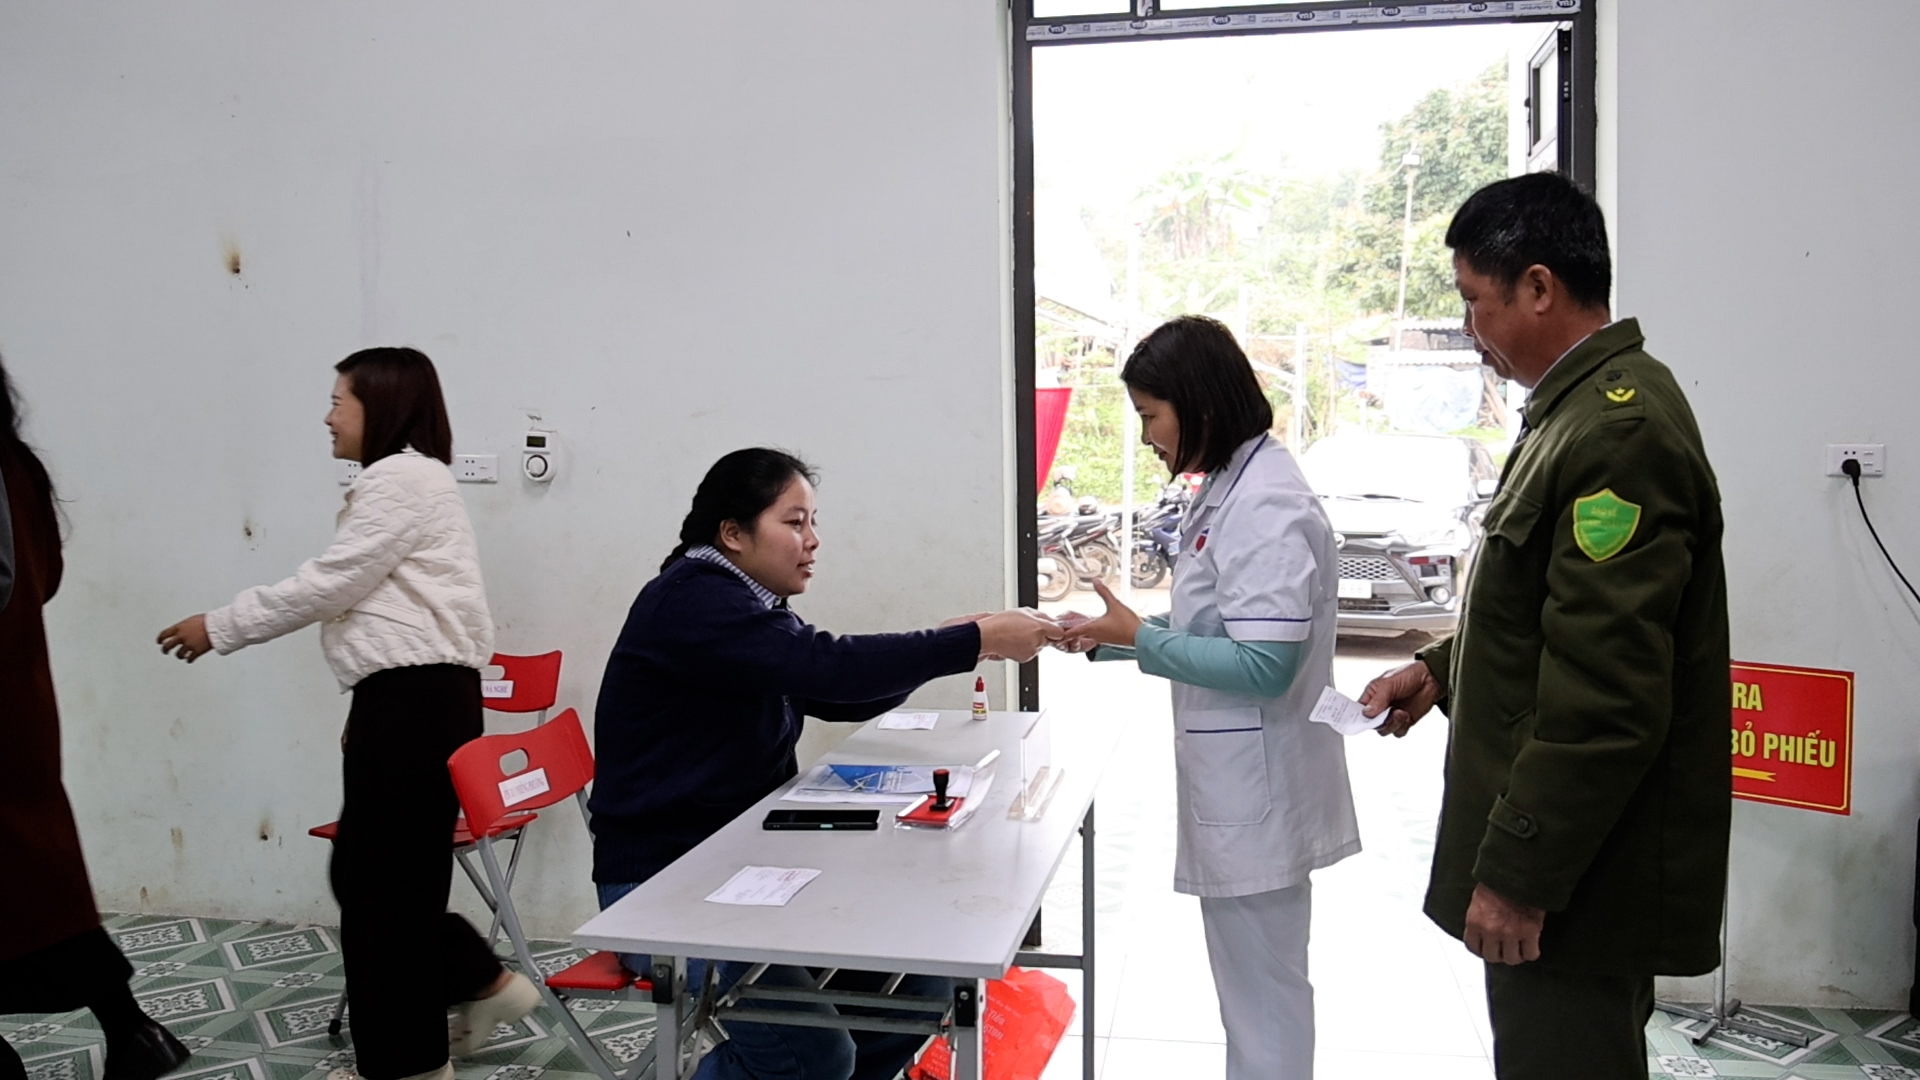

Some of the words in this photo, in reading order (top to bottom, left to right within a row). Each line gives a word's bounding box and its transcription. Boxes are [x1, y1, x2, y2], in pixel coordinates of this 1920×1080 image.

[1732, 682, 1763, 711] RA
[1731, 721, 1756, 757] BỎ
[1763, 729, 1836, 768] PHIẾU
